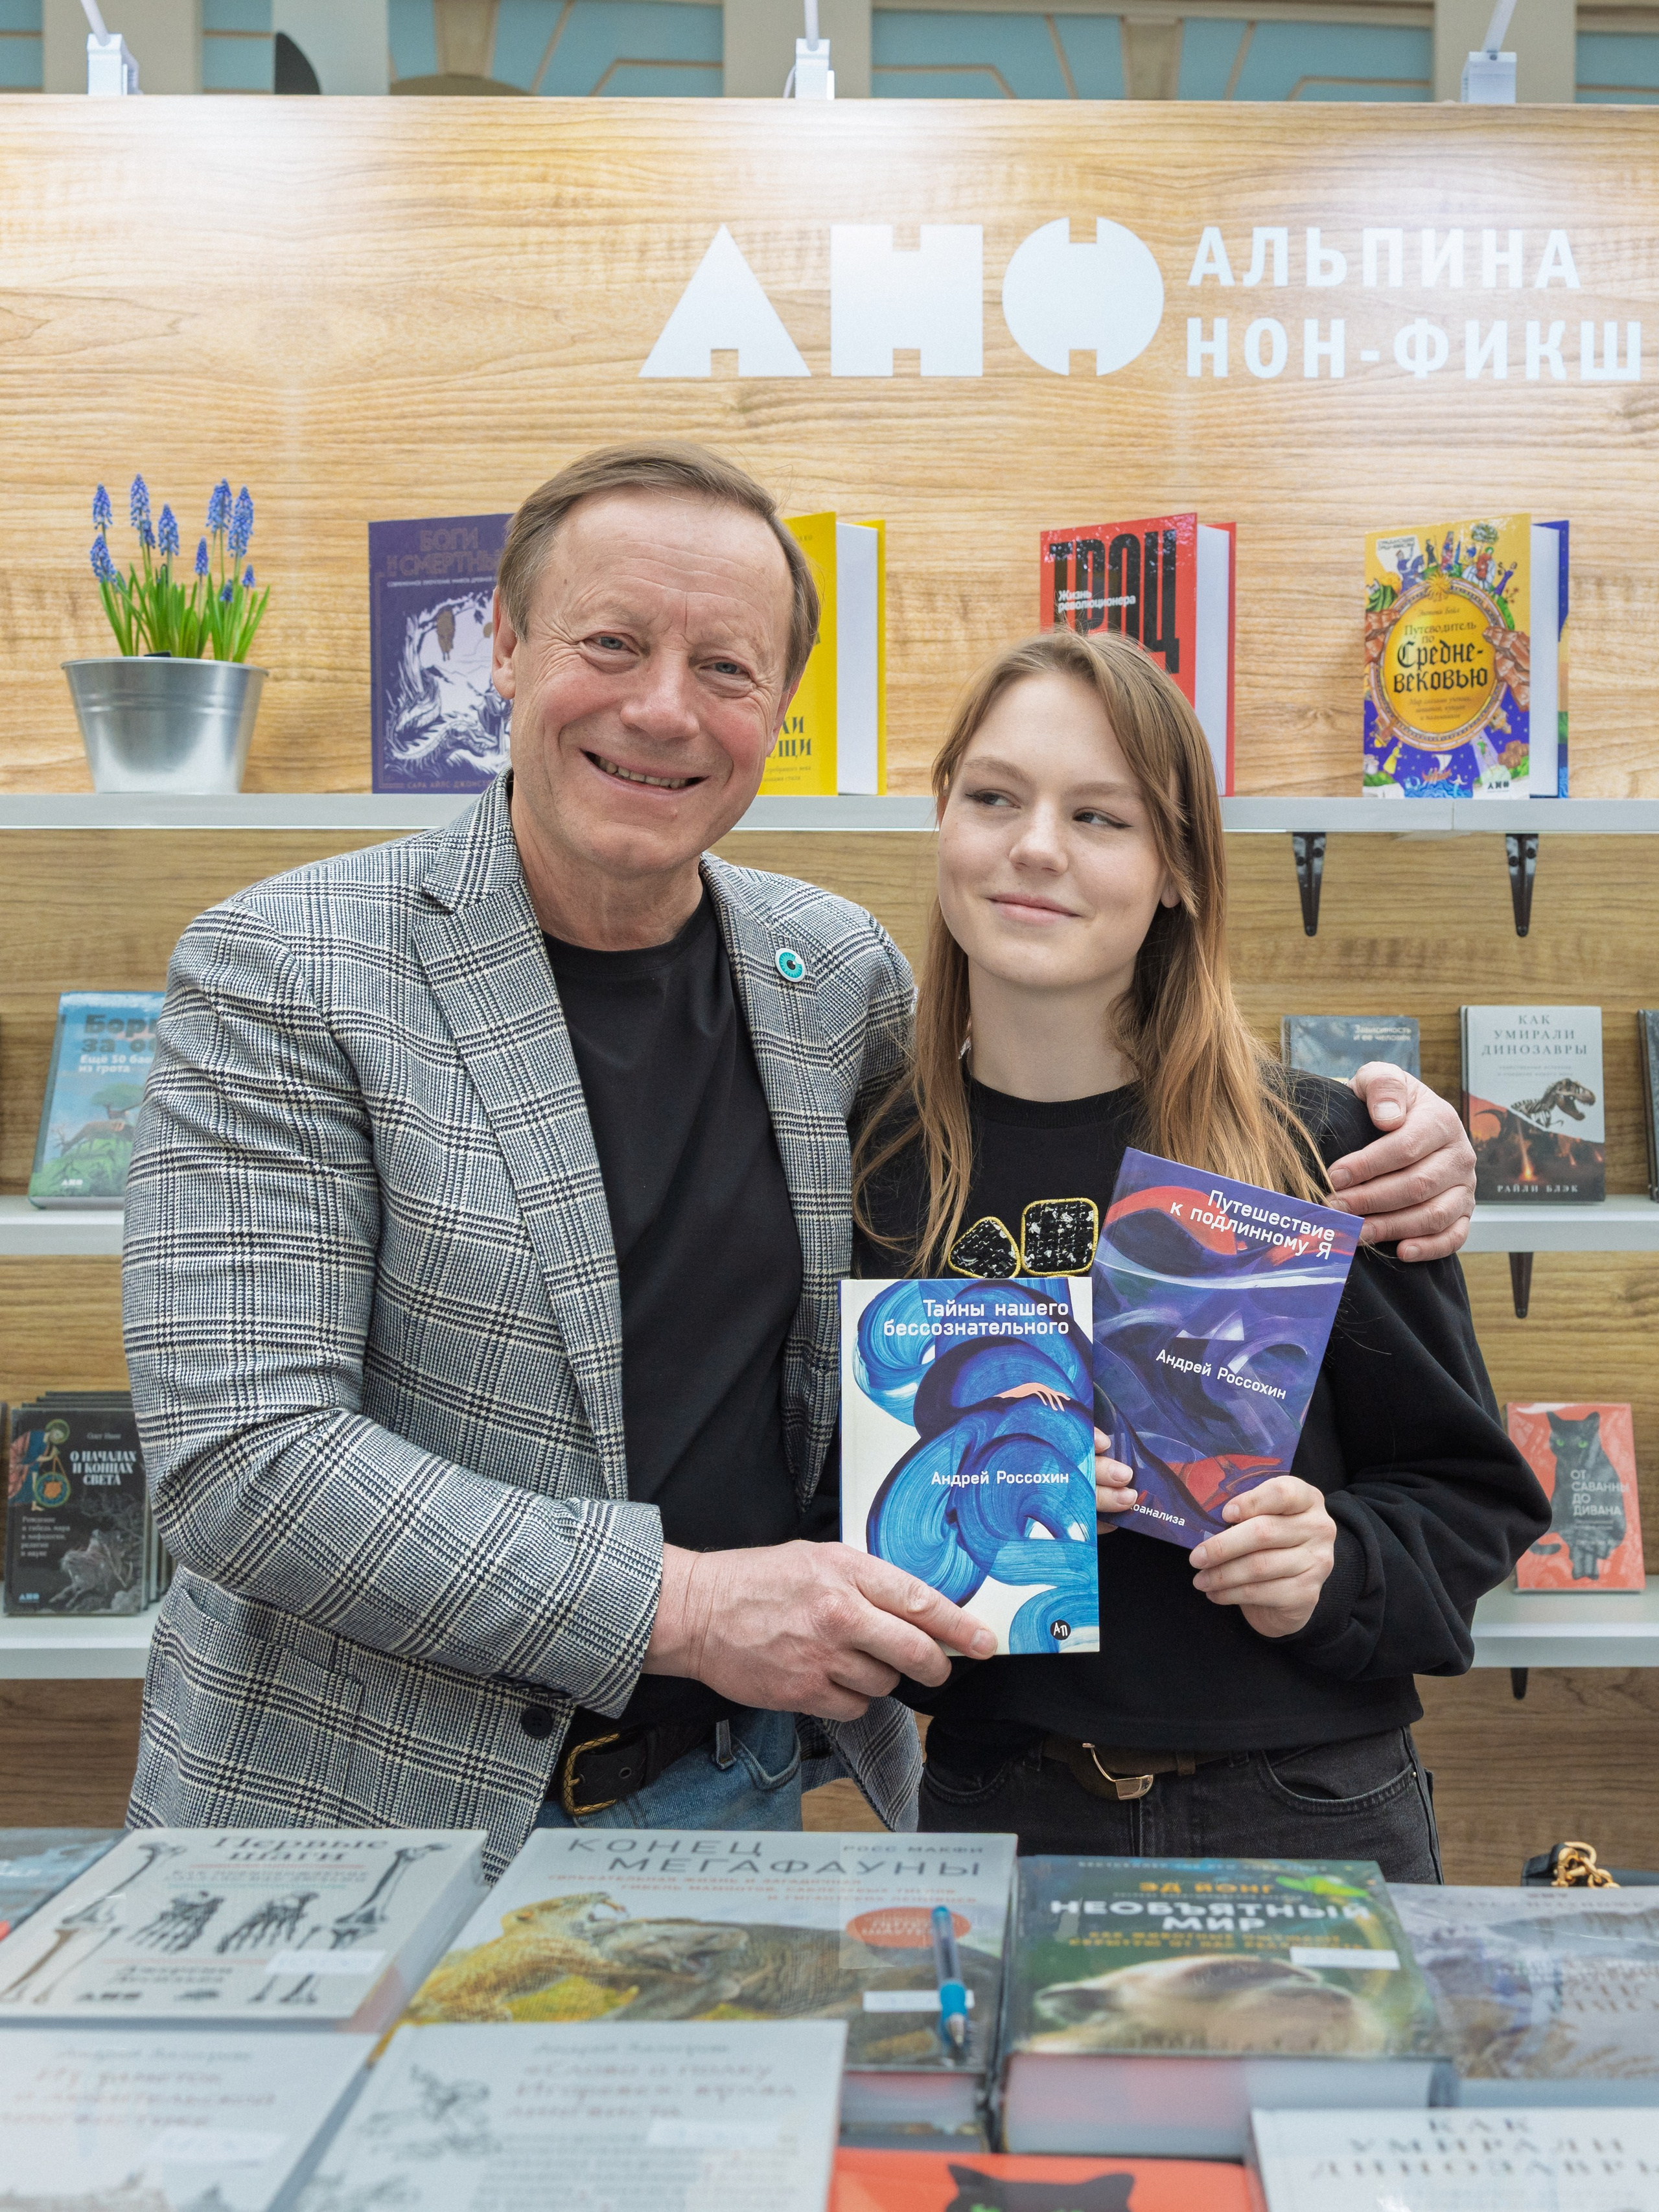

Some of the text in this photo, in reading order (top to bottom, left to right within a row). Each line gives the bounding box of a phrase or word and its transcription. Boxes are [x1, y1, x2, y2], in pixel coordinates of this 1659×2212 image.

[1187, 226, 1583, 290] АЛЬПИНА
[420, 528, 478, 552] БОГИ
[1058, 589, 1093, 601] Жизнь
[1058, 594, 1137, 613] революционера
[1404, 621, 1477, 638] Путеводитель
[1421, 634, 1435, 644] по
[1397, 640, 1484, 673] Средне-
[1393, 668, 1489, 693] вековью
[771, 739, 811, 758] ЩИ
[1518, 1014, 1551, 1025] КАК
[1353, 1024, 1411, 1034] Зависимость
[1494, 1029, 1575, 1041] УМИРАЛИ
[82, 1039, 115, 1053] за
[1481, 1044, 1588, 1056] ДИНОЗАВРЫ
[80, 1054, 108, 1064] Ещё
[129, 1054, 154, 1064] бае
[96, 1065, 131, 1074] грота
[1497, 1184, 1579, 1194] РАЙЛИ БЛЭК
[1207, 1189, 1335, 1242] Путешествие
[1170, 1202, 1332, 1261] к подлинному Я
[923, 1299, 1069, 1318] Тайны нашего
[883, 1319, 1069, 1336] бессознательного
[1155, 1348, 1287, 1401] Андрей Россохин
[69, 1450, 137, 1462] О НАЧАЛАХ
[73, 1462, 134, 1474] И КОНЦАХ
[1570, 1469, 1586, 1480] ОТ
[83, 1474, 122, 1486] СВЕТА
[931, 1470, 1069, 1487] Андрей Россохин
[1571, 1482, 1630, 1493] САВАННЫ
[1572, 1493, 1591, 1504] ДО
[1130, 1503, 1186, 1526] оанализа
[1573, 1506, 1621, 1517] ДИВАНА
[209, 1835, 389, 1853] Первые
[567, 1838, 764, 1856] КОНЕЦ
[608, 1857, 980, 1878] МЕГАФАУНЫ
[1139, 1880, 1275, 1894] ЭД ЙОНГ
[1050, 1899, 1371, 1920] НЕОБЪЯТНЫЙ
[1161, 1916, 1267, 1931] МИР
